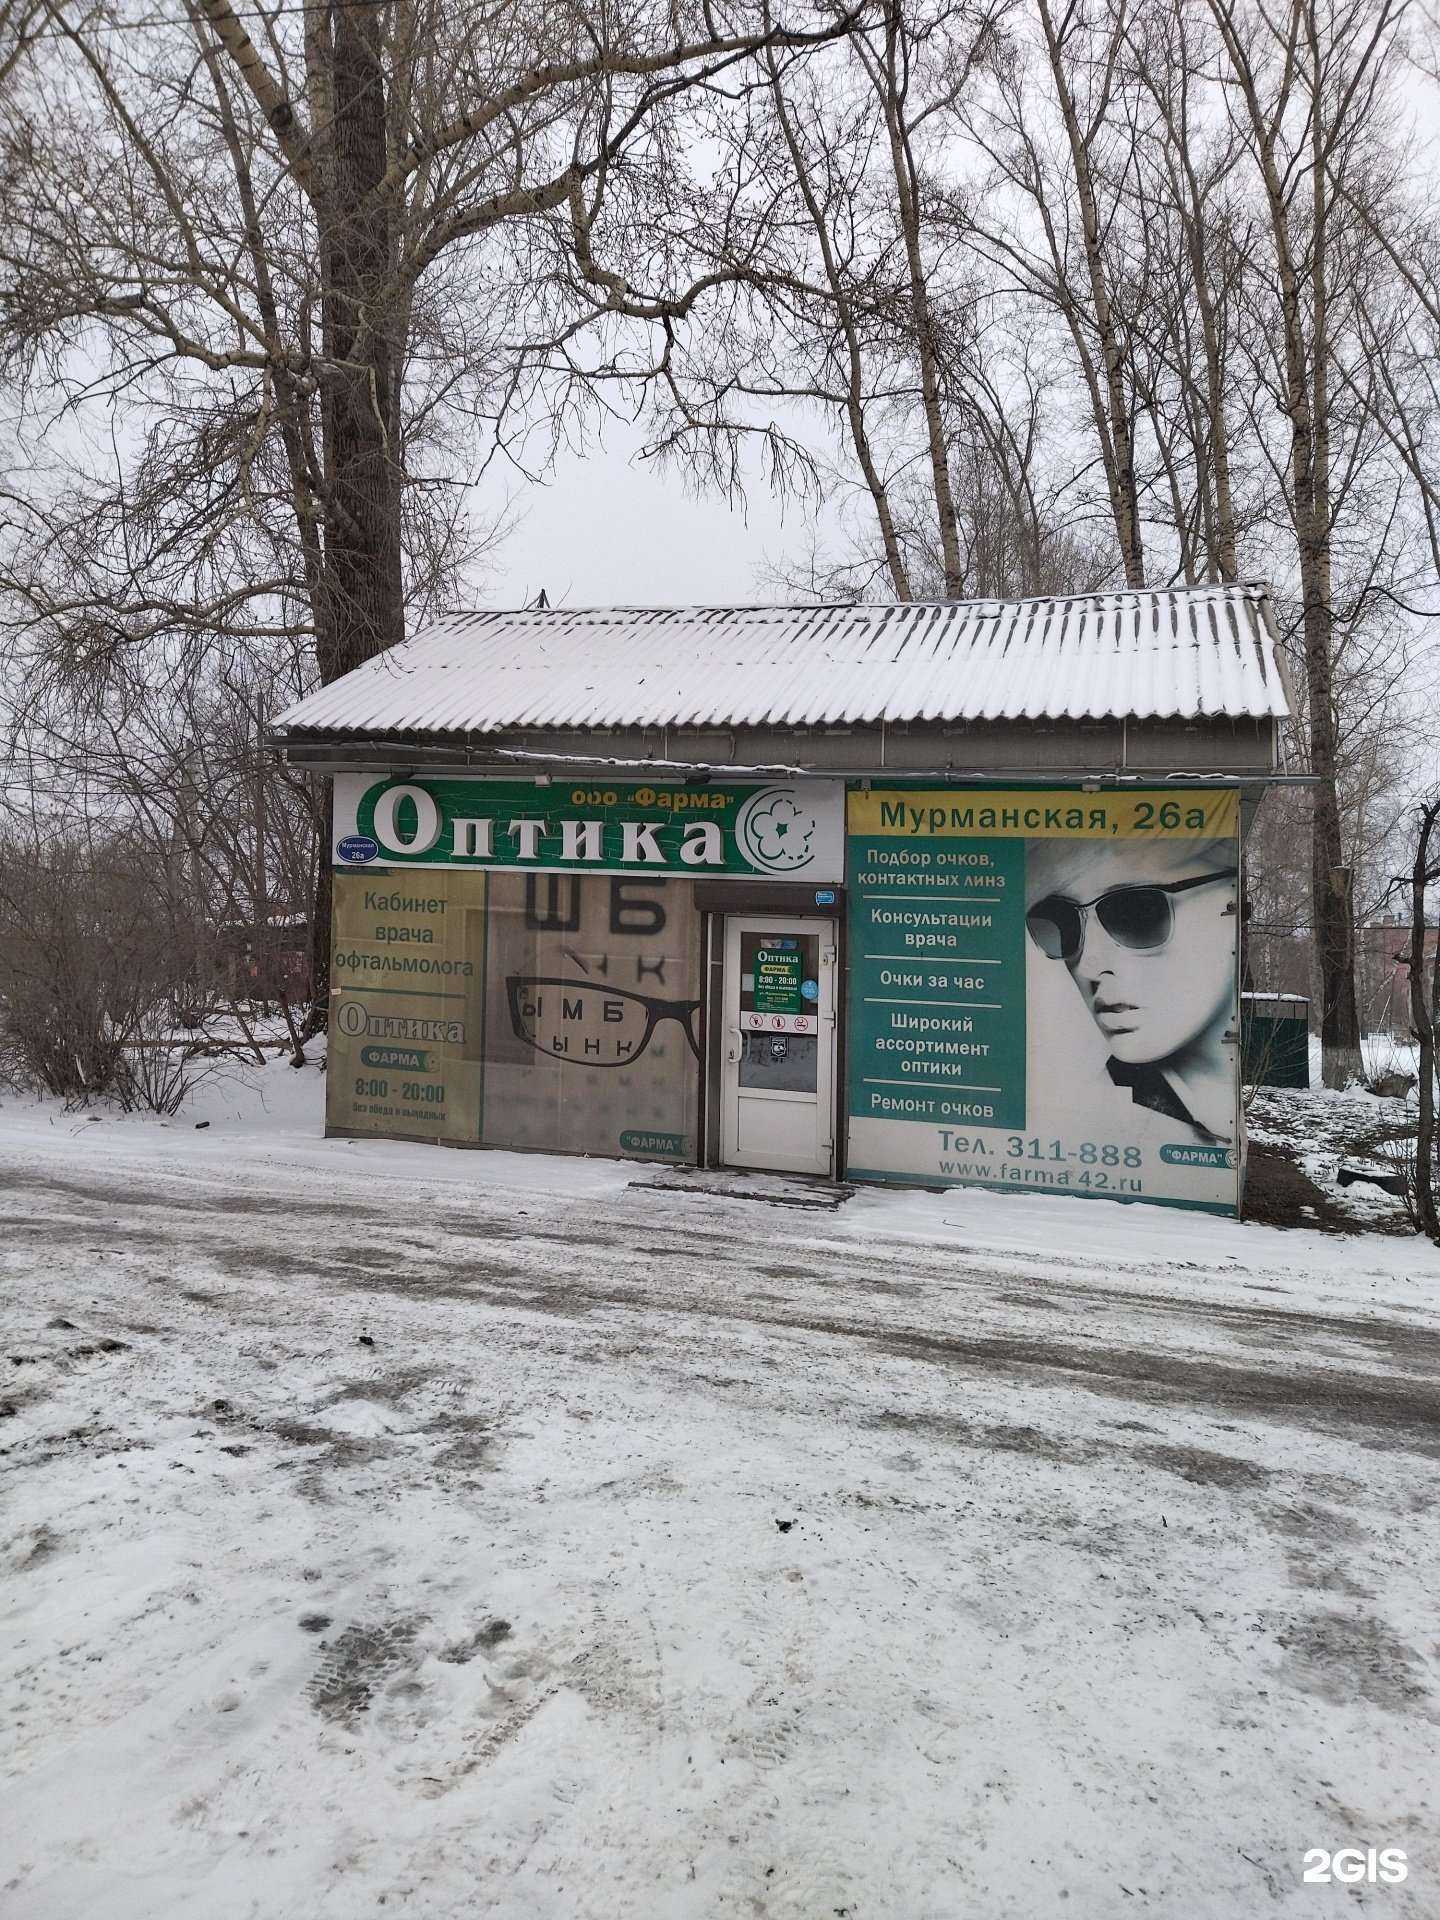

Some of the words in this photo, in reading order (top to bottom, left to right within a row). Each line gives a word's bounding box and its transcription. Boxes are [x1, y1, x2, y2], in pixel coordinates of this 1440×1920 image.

[374, 784, 724, 865] Оптика
[880, 801, 1119, 834] Мурманская,
[1133, 801, 1206, 830] 26а
[867, 849, 931, 867] Подбор
[936, 853, 995, 868] очков,
[857, 873, 959, 886] контактных
[964, 875, 1006, 888] линз
[364, 891, 449, 914] Кабинет
[610, 876, 666, 935] Б
[871, 908, 992, 928] Консультации
[375, 926, 434, 944] врача
[905, 933, 957, 948] врача
[335, 950, 474, 977] офтальмолога
[757, 950, 799, 963] Оптика
[778, 976, 797, 985] 20:00
[880, 970, 922, 986] Очки
[928, 975, 948, 988] за
[953, 976, 985, 989] час
[562, 998, 583, 1020] М
[603, 1000, 624, 1022] Б
[338, 1001, 465, 1044] Оптика
[891, 1012, 973, 1032] Широкий
[875, 1038, 990, 1056] ассортимент
[368, 1052, 420, 1067] ФАРМА
[901, 1060, 962, 1076] оптики
[355, 1078, 388, 1098] 8:00
[402, 1082, 445, 1103] 20:00
[871, 1093, 935, 1113] Ремонт
[941, 1102, 994, 1117] очков
[938, 1130, 995, 1156] Тел.
[1006, 1136, 1143, 1168] 311-888
